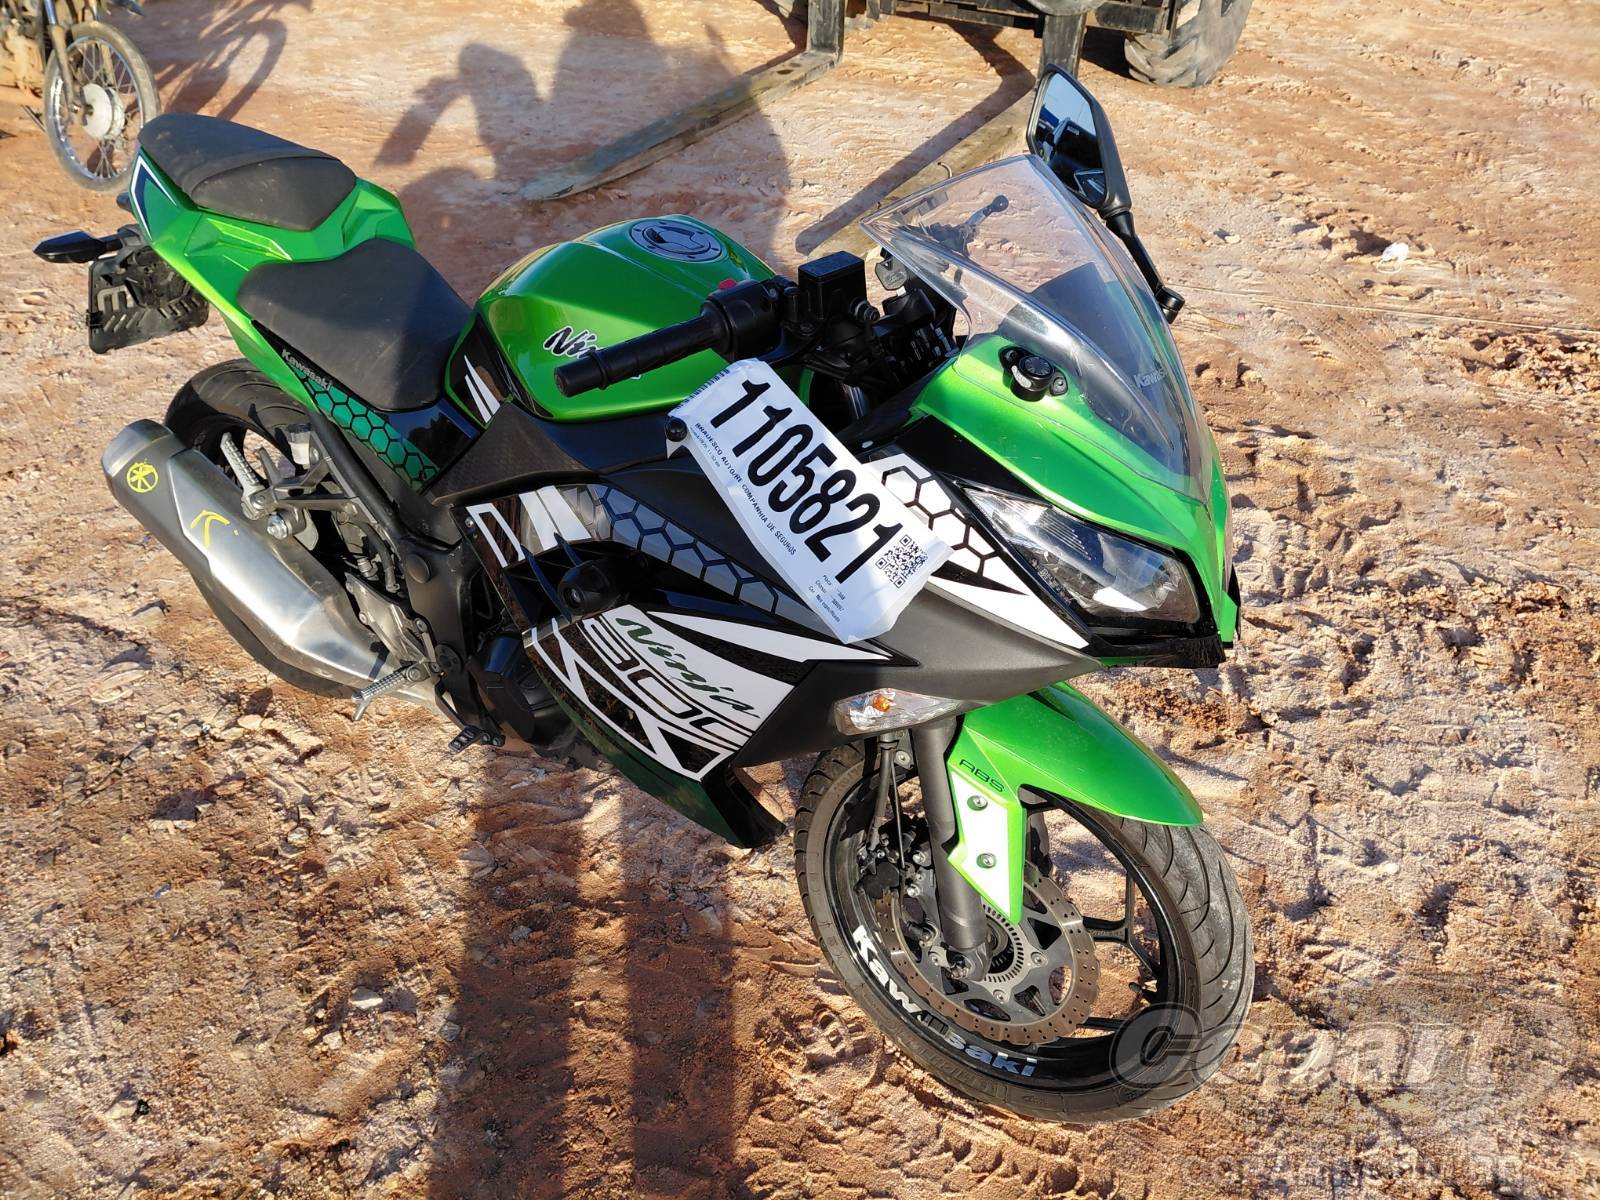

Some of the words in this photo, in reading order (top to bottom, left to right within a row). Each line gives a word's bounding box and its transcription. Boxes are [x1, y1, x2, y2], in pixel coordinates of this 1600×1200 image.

[281, 349, 333, 391] Kawasaki
[710, 379, 903, 584] 1105821
[741, 484, 768, 524] COMPANHIA
[774, 530, 797, 556] SEGUROS
[615, 617, 761, 719] Ninja
[959, 758, 1005, 793] ABS
[852, 924, 1038, 1077] Kawsaki
